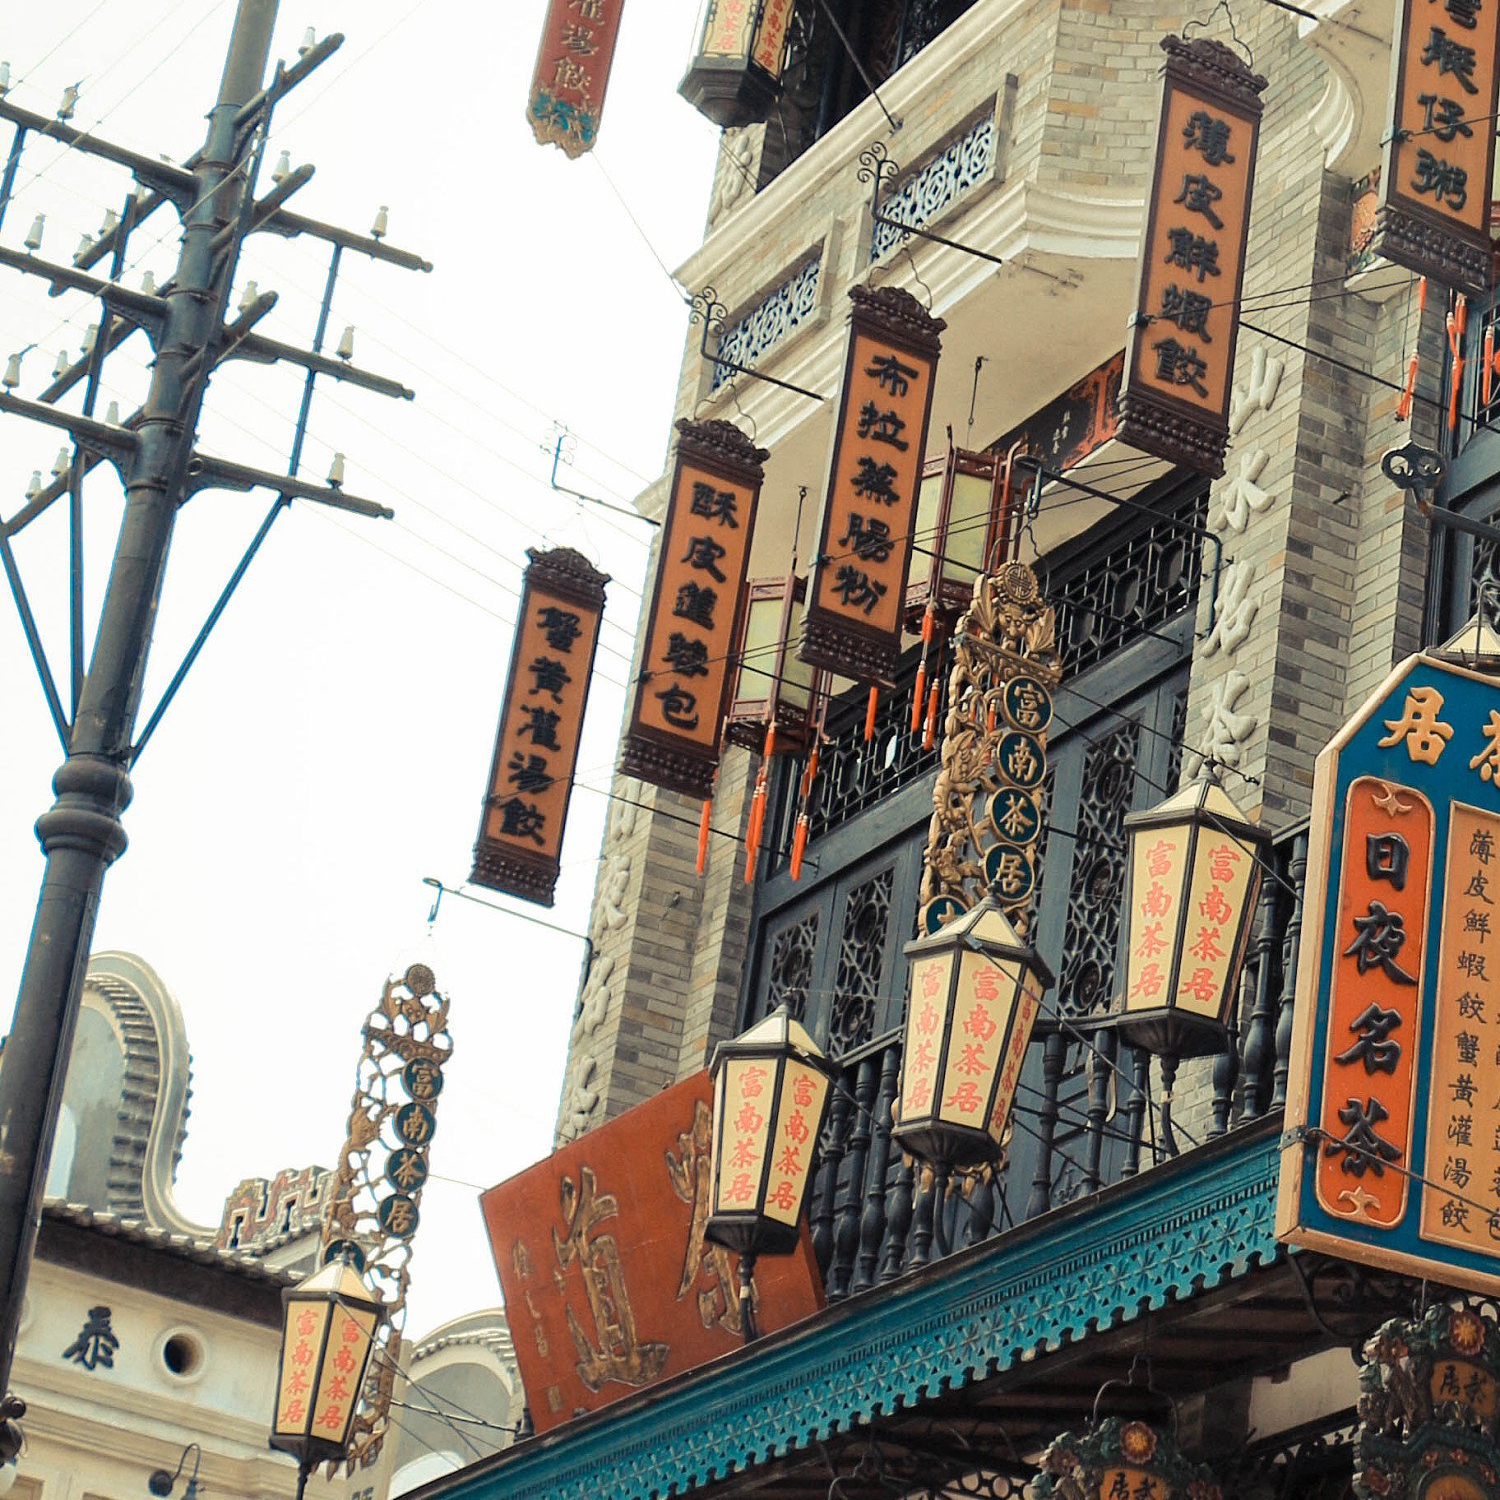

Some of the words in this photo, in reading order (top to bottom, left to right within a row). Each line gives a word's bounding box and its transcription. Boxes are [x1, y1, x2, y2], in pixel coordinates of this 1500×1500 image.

[1150, 111, 1237, 402] 薄皮鮮蝦餃
[835, 354, 920, 615] 布拉蒸腸粉
[655, 480, 740, 732] 酥皮蓮蓉包
[995, 682, 1045, 894] 富南茶居
[1129, 840, 1177, 999] 富南茶居
[1178, 844, 1241, 1002] 富南茶居
[904, 963, 944, 1111] 富南茶居
[943, 965, 1005, 1114] 富南茶居
[1325, 832, 1421, 1179] 日夜名茶
[385, 1062, 437, 1233] 富南茶居
[723, 1066, 768, 1203] 富南茶居
[765, 1073, 818, 1212] 富南茶居
[278, 1308, 319, 1426] 富南茶居
[314, 1316, 365, 1431] 富南茶居
